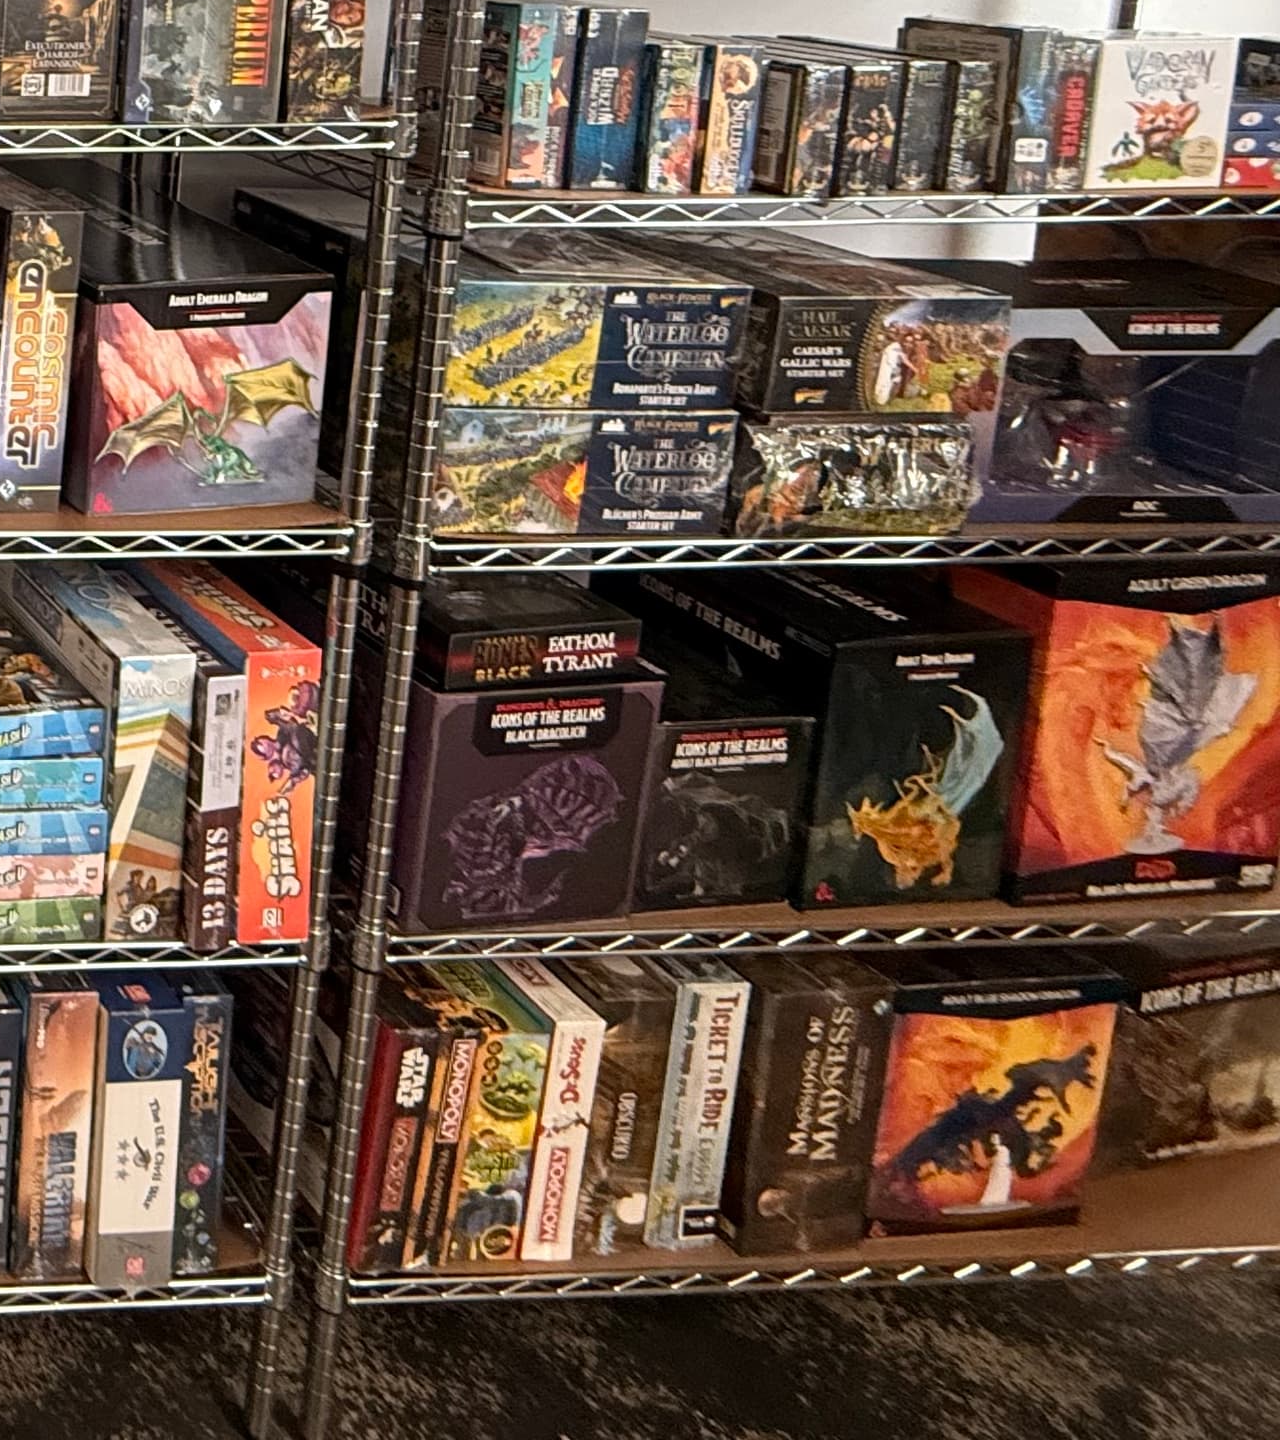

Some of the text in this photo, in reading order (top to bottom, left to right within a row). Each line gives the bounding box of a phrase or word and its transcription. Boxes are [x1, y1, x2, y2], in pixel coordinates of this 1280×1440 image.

[542, 654, 618, 673] TYRANT
[548, 633, 616, 653] FATHOM
[475, 665, 532, 682] BLACK
[490, 707, 605, 728] ICONS OF THE REALMS
[505, 728, 535, 742] BLACK
[676, 738, 788, 756] ICONS OF THE REALMS
[203, 827, 228, 931] 13 DAYS
[437, 1039, 476, 1143] MONOPOLY
[699, 994, 740, 1135] TICKET RIDE
[787, 1016, 826, 1156] MANSIONS OF
[809, 1005, 855, 1161] MADNESS
[541, 1146, 569, 1243] MONOPOLY
